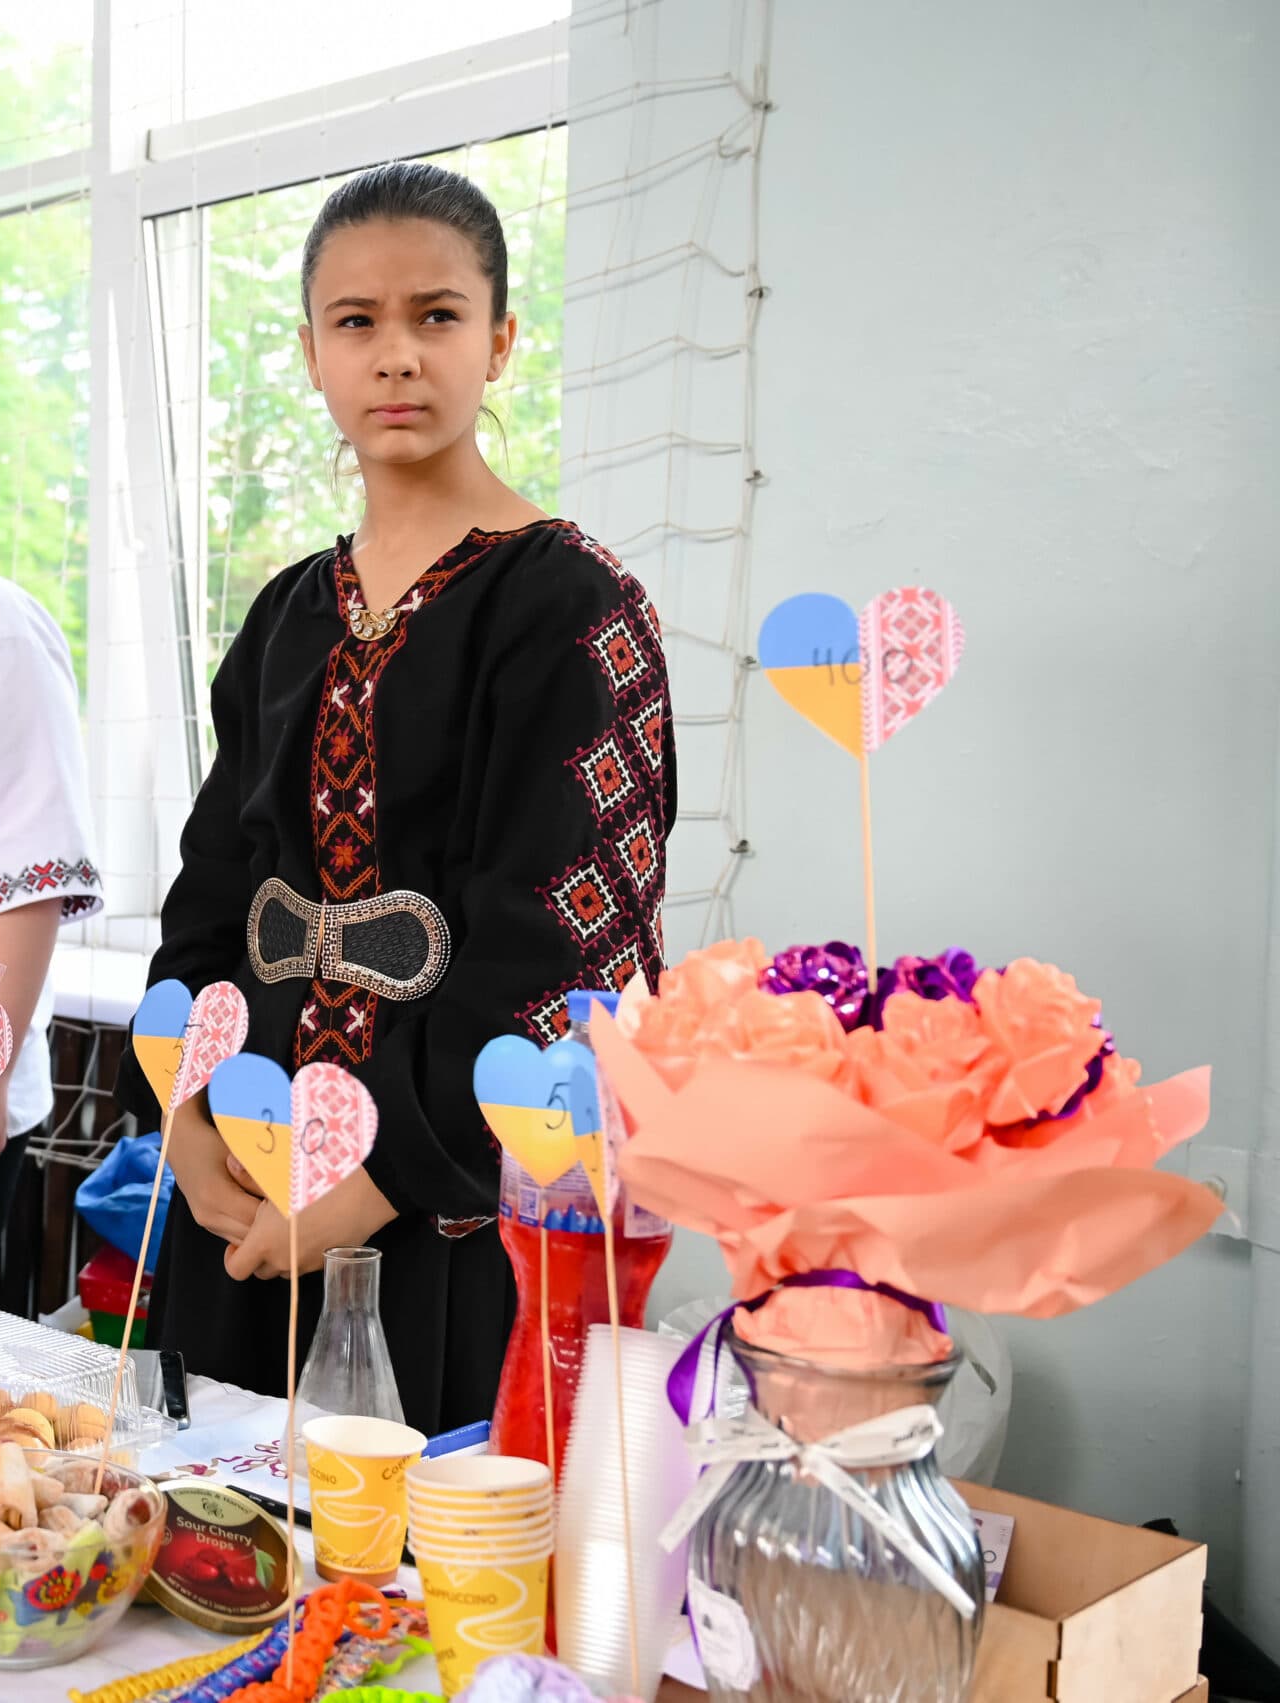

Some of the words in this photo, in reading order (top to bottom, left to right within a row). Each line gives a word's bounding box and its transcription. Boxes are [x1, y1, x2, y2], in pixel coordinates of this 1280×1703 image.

[256, 1107, 327, 1155] 30
[176, 1515, 206, 1532] Sour
[209, 1525, 253, 1546] Cherry
[195, 1532, 235, 1551] Drops
